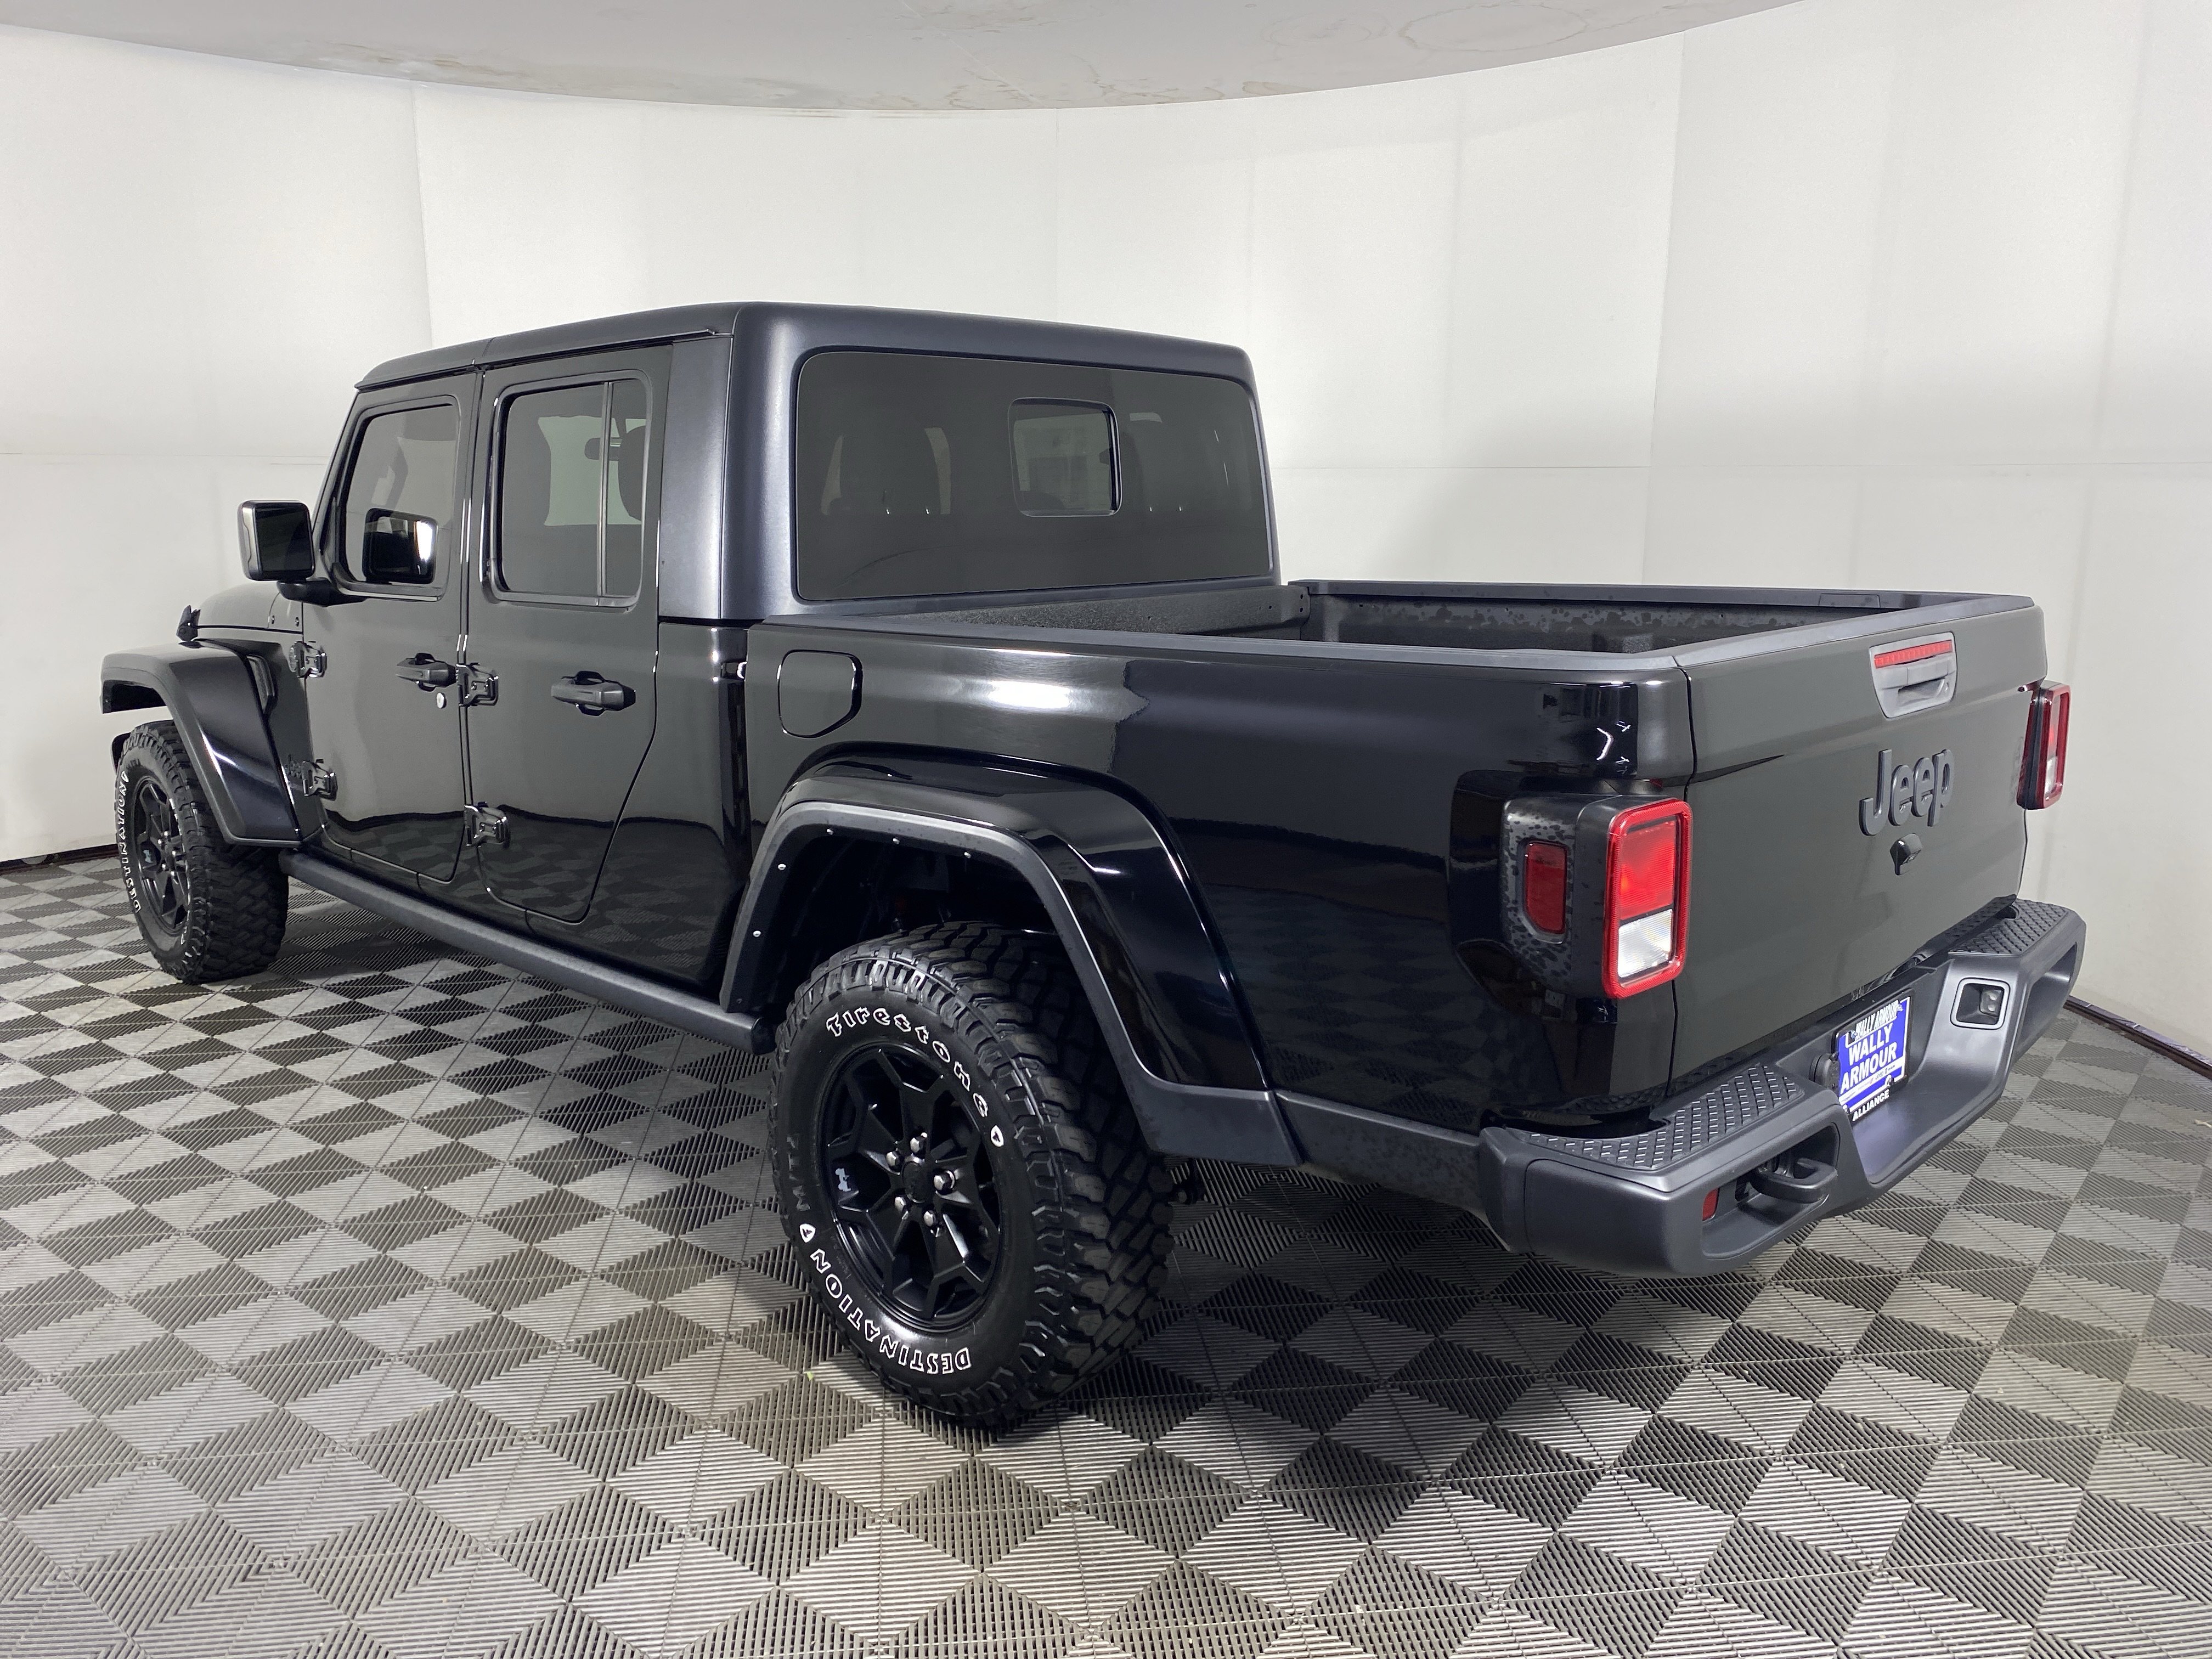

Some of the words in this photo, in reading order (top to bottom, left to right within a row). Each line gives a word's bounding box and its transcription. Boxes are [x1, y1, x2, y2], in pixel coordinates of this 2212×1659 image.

[1859, 749, 1954, 836] Jeep
[116, 782, 141, 913] DESTINATION
[1849, 1022, 1893, 1066] WALLY
[1854, 1013, 1876, 1041] WALLY
[1874, 1000, 1898, 1030] ARMOUR
[826, 1008, 988, 1118] Firestone
[1840, 1042, 1897, 1094] ARMOUR
[1852, 1089, 1889, 1121] ALLIANCE
[809, 1248, 973, 1375] DESTINATION
